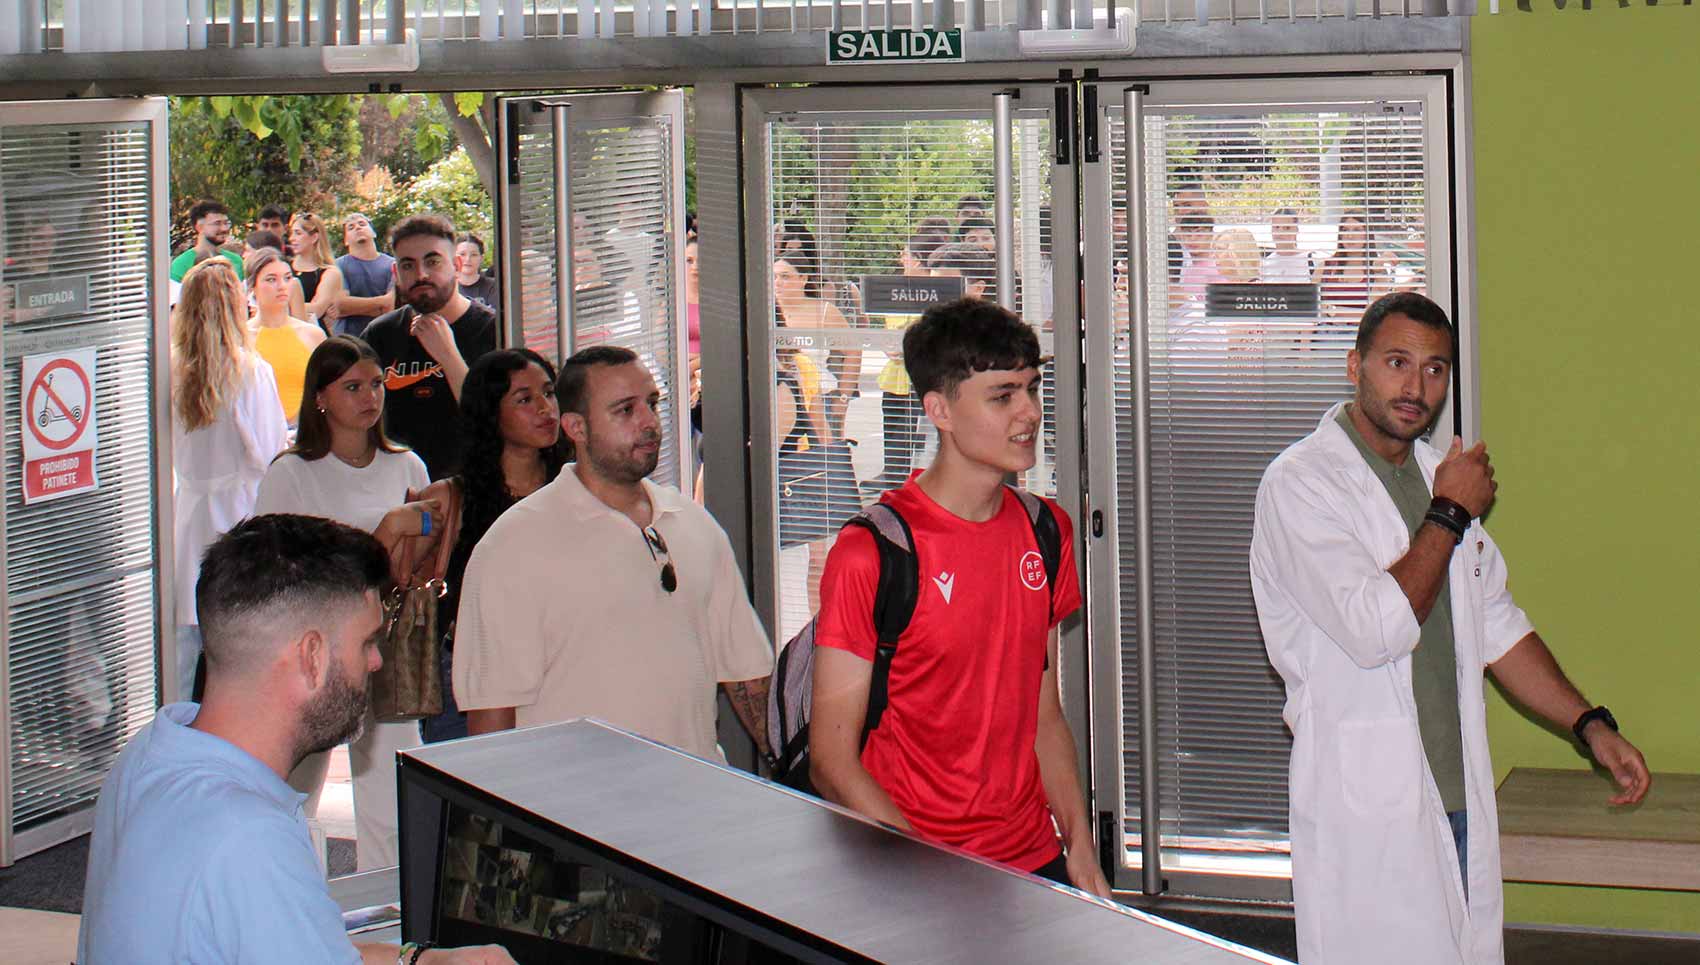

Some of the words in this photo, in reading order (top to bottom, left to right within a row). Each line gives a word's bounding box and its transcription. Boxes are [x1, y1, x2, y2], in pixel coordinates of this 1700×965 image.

[837, 32, 954, 58] SALIDA
[28, 290, 75, 307] ENTRADA
[890, 288, 939, 302] SALIDA
[1235, 296, 1289, 310] SALIDA
[383, 361, 444, 382] NIK
[40, 457, 80, 475] PROHIBIDO
[42, 472, 78, 490] PATINETE
[1026, 560, 1040, 570] RF
[1027, 571, 1042, 581] EF
